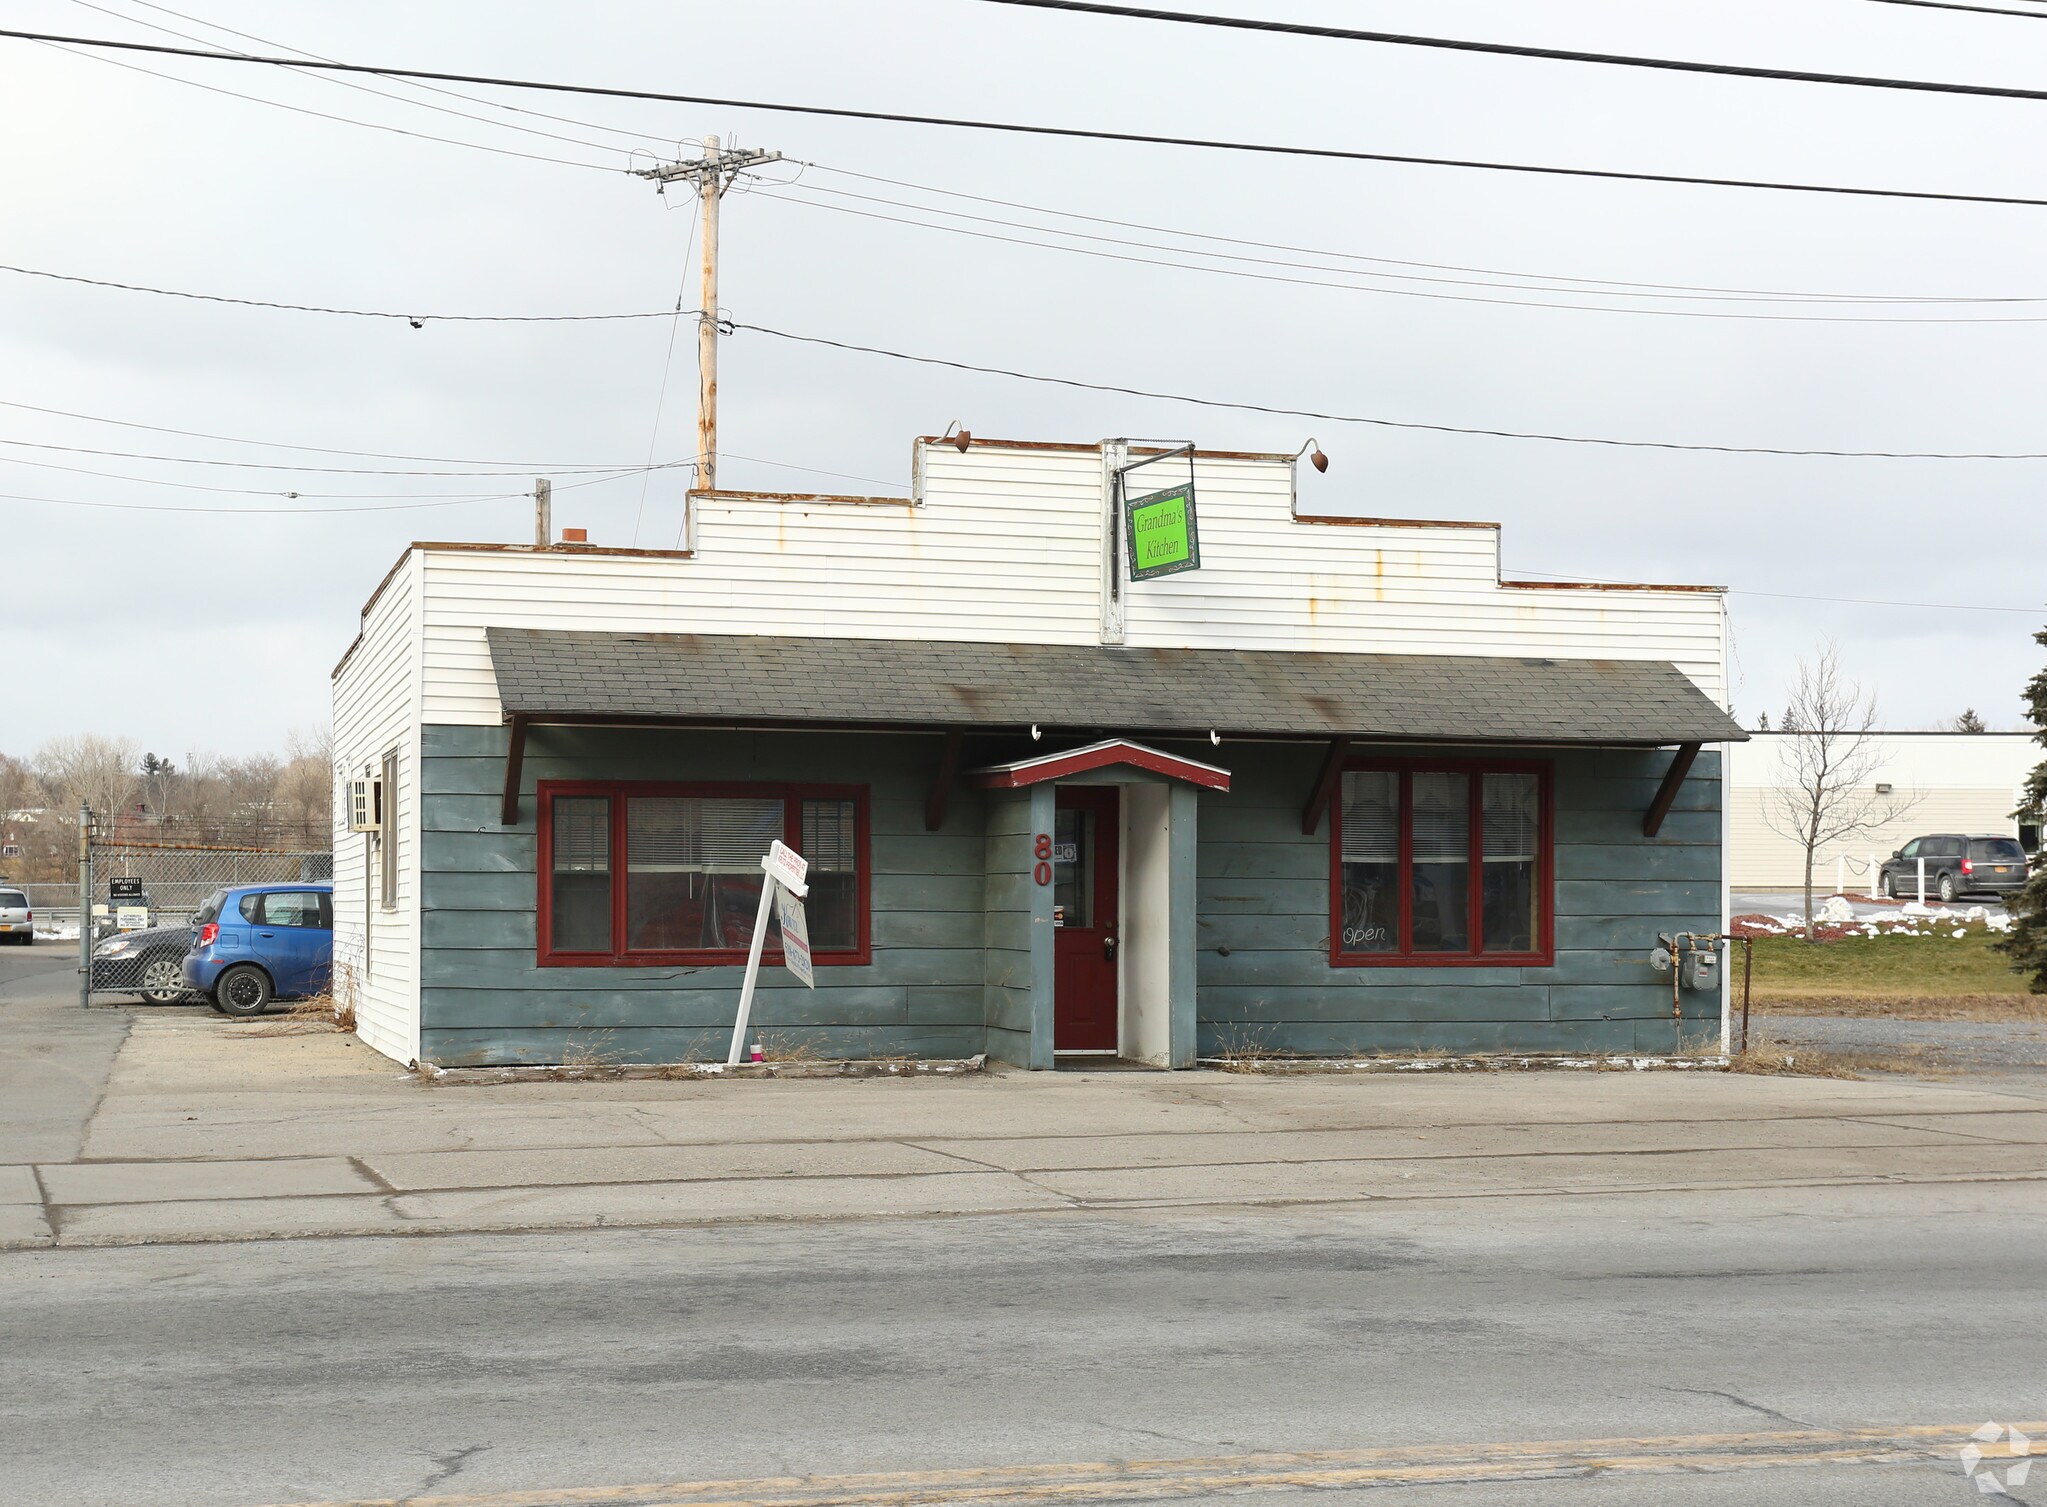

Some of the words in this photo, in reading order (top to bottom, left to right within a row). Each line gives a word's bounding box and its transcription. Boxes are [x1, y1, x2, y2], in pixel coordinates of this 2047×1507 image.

[1137, 505, 1182, 533] Grandma's
[1146, 537, 1179, 560] Kitchen
[1034, 833, 1052, 887] 80
